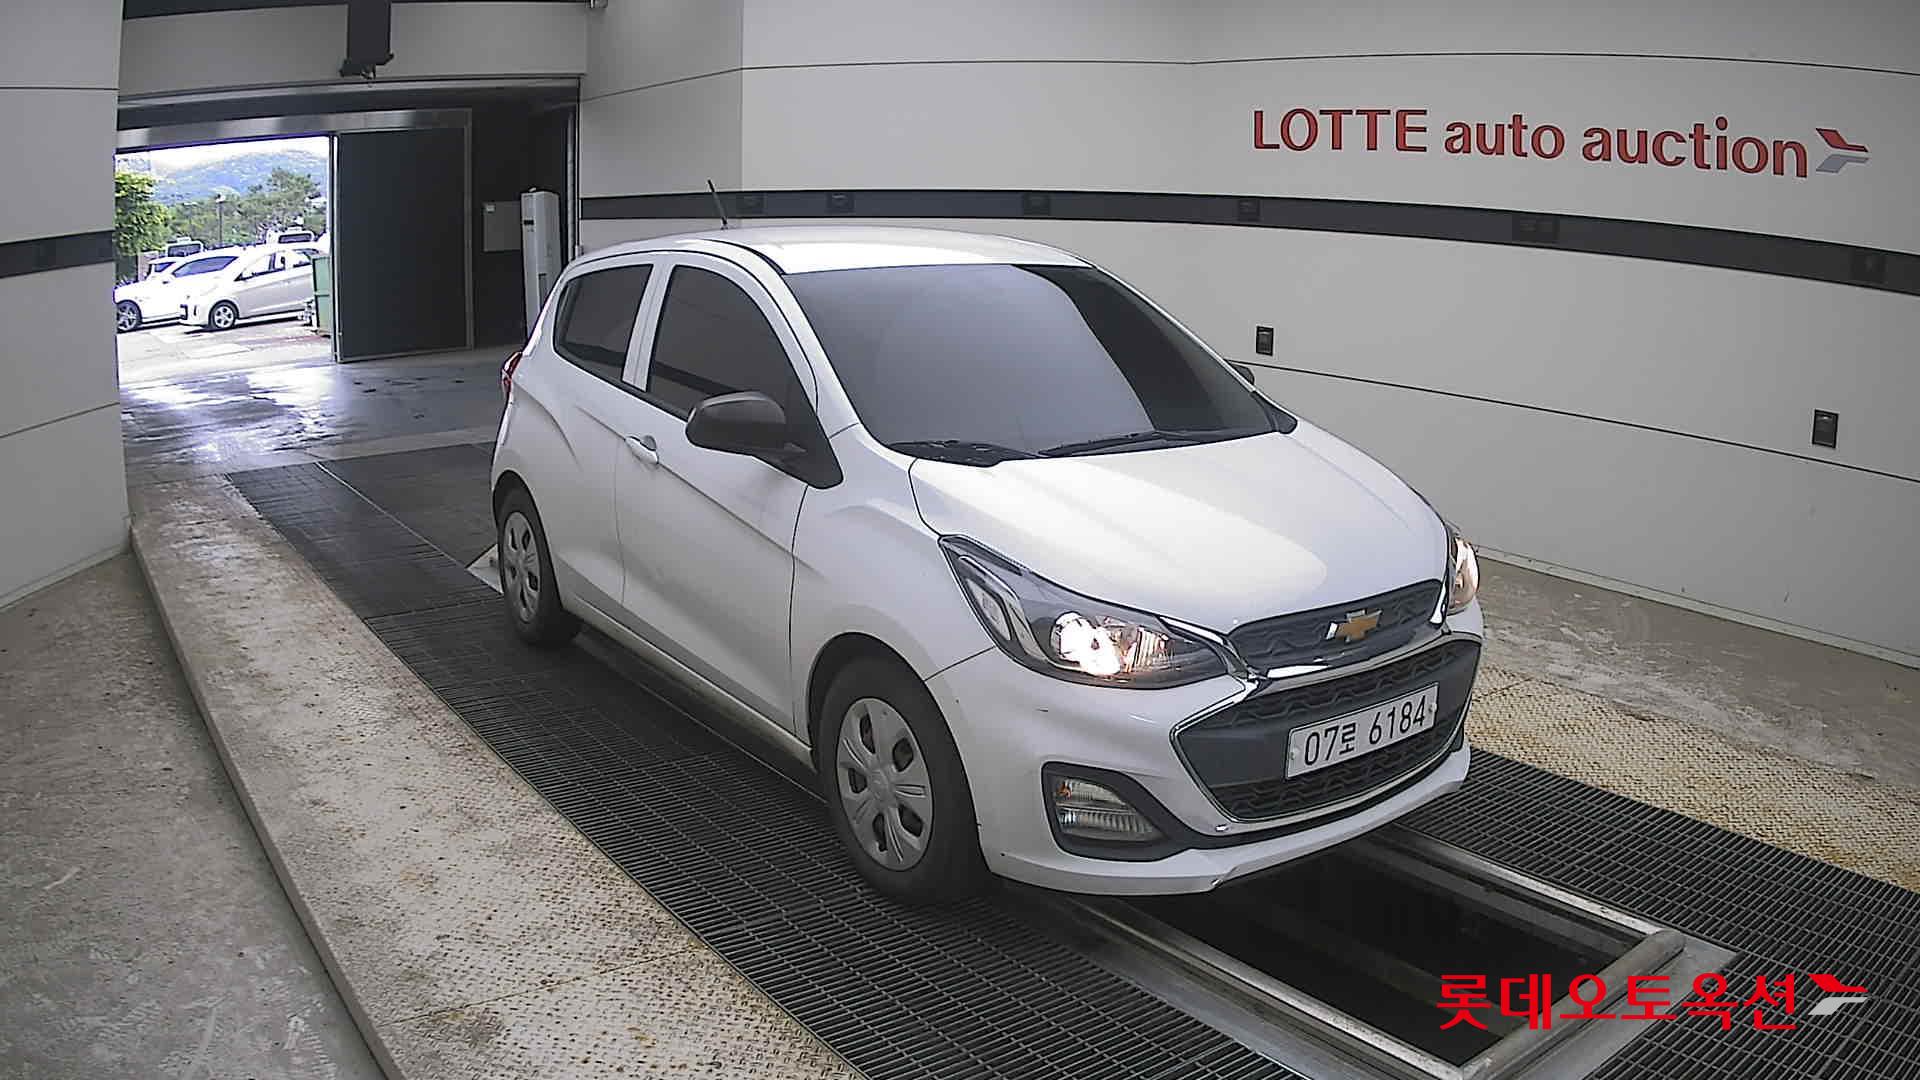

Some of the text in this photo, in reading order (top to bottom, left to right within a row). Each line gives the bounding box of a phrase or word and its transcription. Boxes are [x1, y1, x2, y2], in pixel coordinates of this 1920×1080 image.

[1253, 108, 1808, 178] LOTTE auto auction
[1304, 695, 1426, 766] 07로 6184
